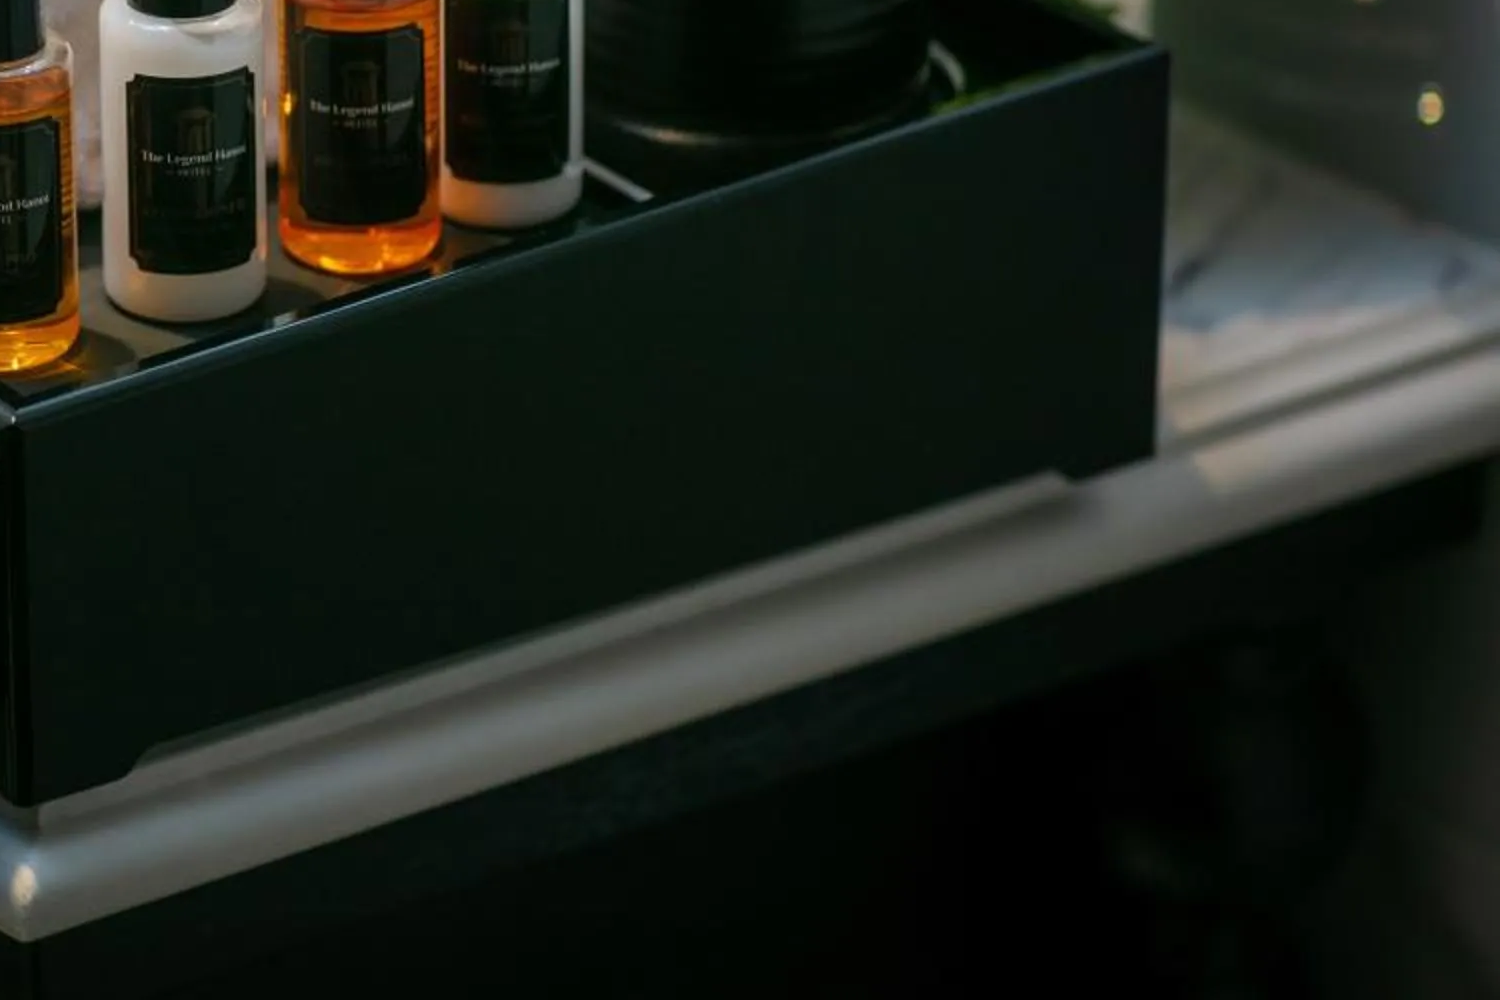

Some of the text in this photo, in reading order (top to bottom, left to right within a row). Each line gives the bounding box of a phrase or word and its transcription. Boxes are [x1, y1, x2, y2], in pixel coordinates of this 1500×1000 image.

[310, 99, 331, 113] The
[141, 149, 164, 162] The
[167, 152, 213, 166] Legend
